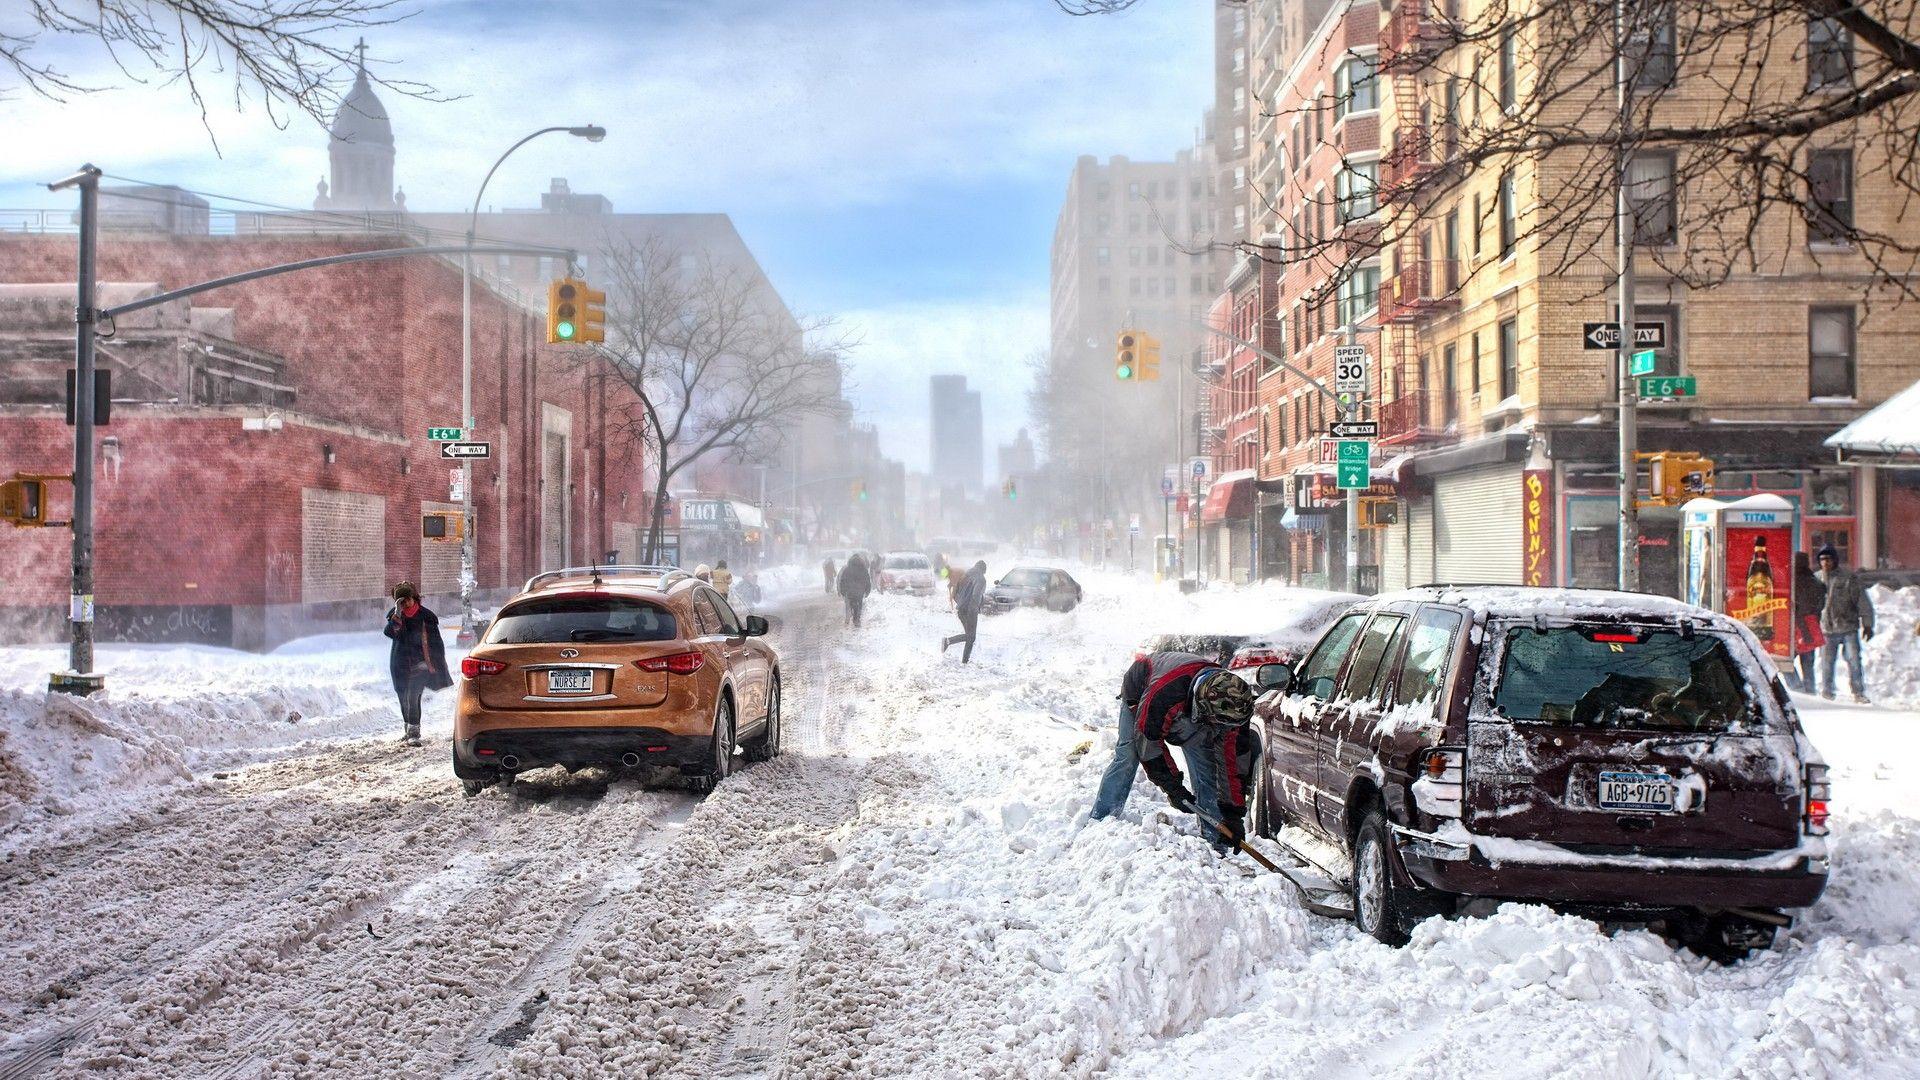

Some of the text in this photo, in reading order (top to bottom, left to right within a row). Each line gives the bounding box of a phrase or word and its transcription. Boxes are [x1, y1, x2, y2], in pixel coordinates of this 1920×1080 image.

[1596, 331, 1618, 341] ONE
[1337, 348, 1364, 356] SPEED
[1339, 356, 1360, 364] LIMIT
[1338, 364, 1362, 379] 30
[1646, 379, 1686, 395] E 6 ST
[432, 429, 439, 439] E
[441, 429, 448, 439] 6
[1743, 513, 1776, 522] TITAN
[554, 676, 587, 688] NURSE P
